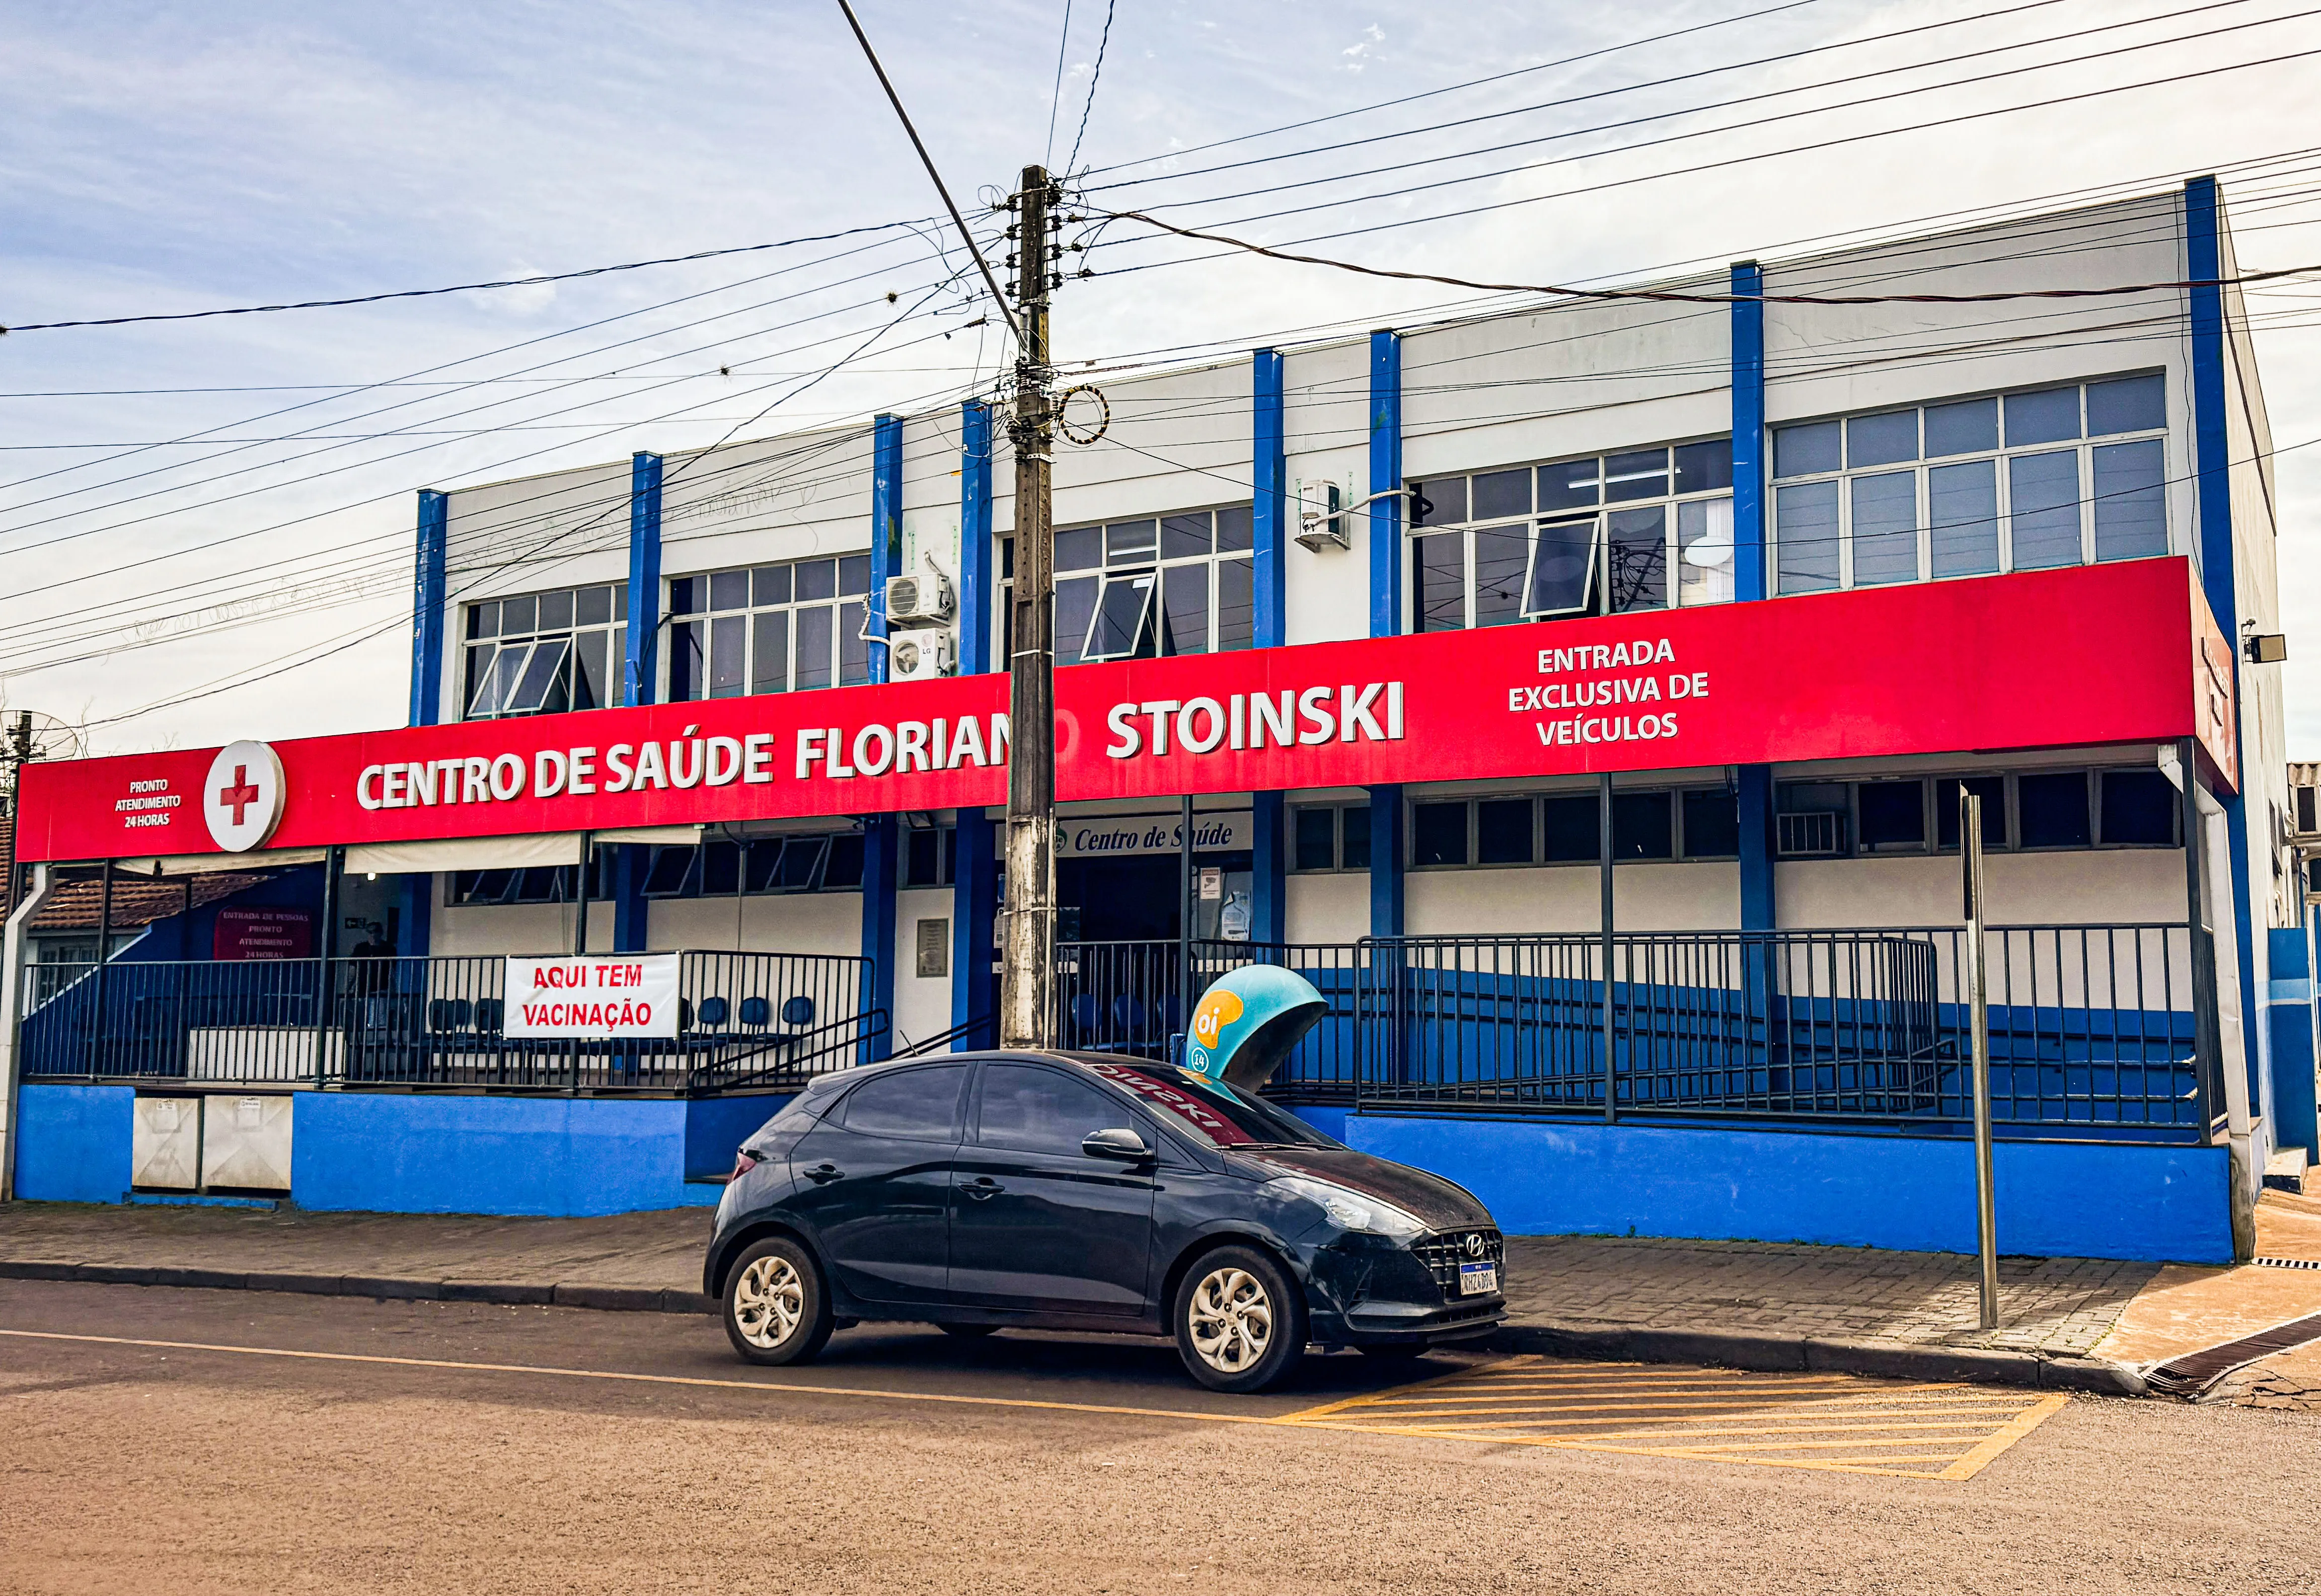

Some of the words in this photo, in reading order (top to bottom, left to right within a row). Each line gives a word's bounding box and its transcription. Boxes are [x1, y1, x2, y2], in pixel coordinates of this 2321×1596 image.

[1538, 638, 1675, 674] ENTRADA
[1509, 677, 1661, 712] EXCLUSIVA
[1669, 672, 1709, 699] DE
[1536, 712, 1678, 746] VEÍCULOS
[357, 753, 525, 810] CENTRO
[535, 746, 596, 798] DE
[604, 724, 774, 793] SAÚDE
[1107, 681, 1404, 759] STOINSKI
[130, 779, 168, 793] PRONTO
[115, 795, 181, 811] ATENDIMENTO
[125, 816, 137, 828] 24
[137, 813, 170, 827] HORAS
[1075, 828, 1138, 851] Centro
[1143, 826, 1166, 848] de
[1170, 821, 1232, 847] Súde
[239, 938, 293, 946] ATENDIMENTO
[534, 965, 587, 988] AQUI
[595, 964, 642, 988] TEM
[522, 997, 652, 1032] VACINAÇÃO
[1198, 1007, 1220, 1035] oi
[1194, 1054, 1205, 1067] 14
